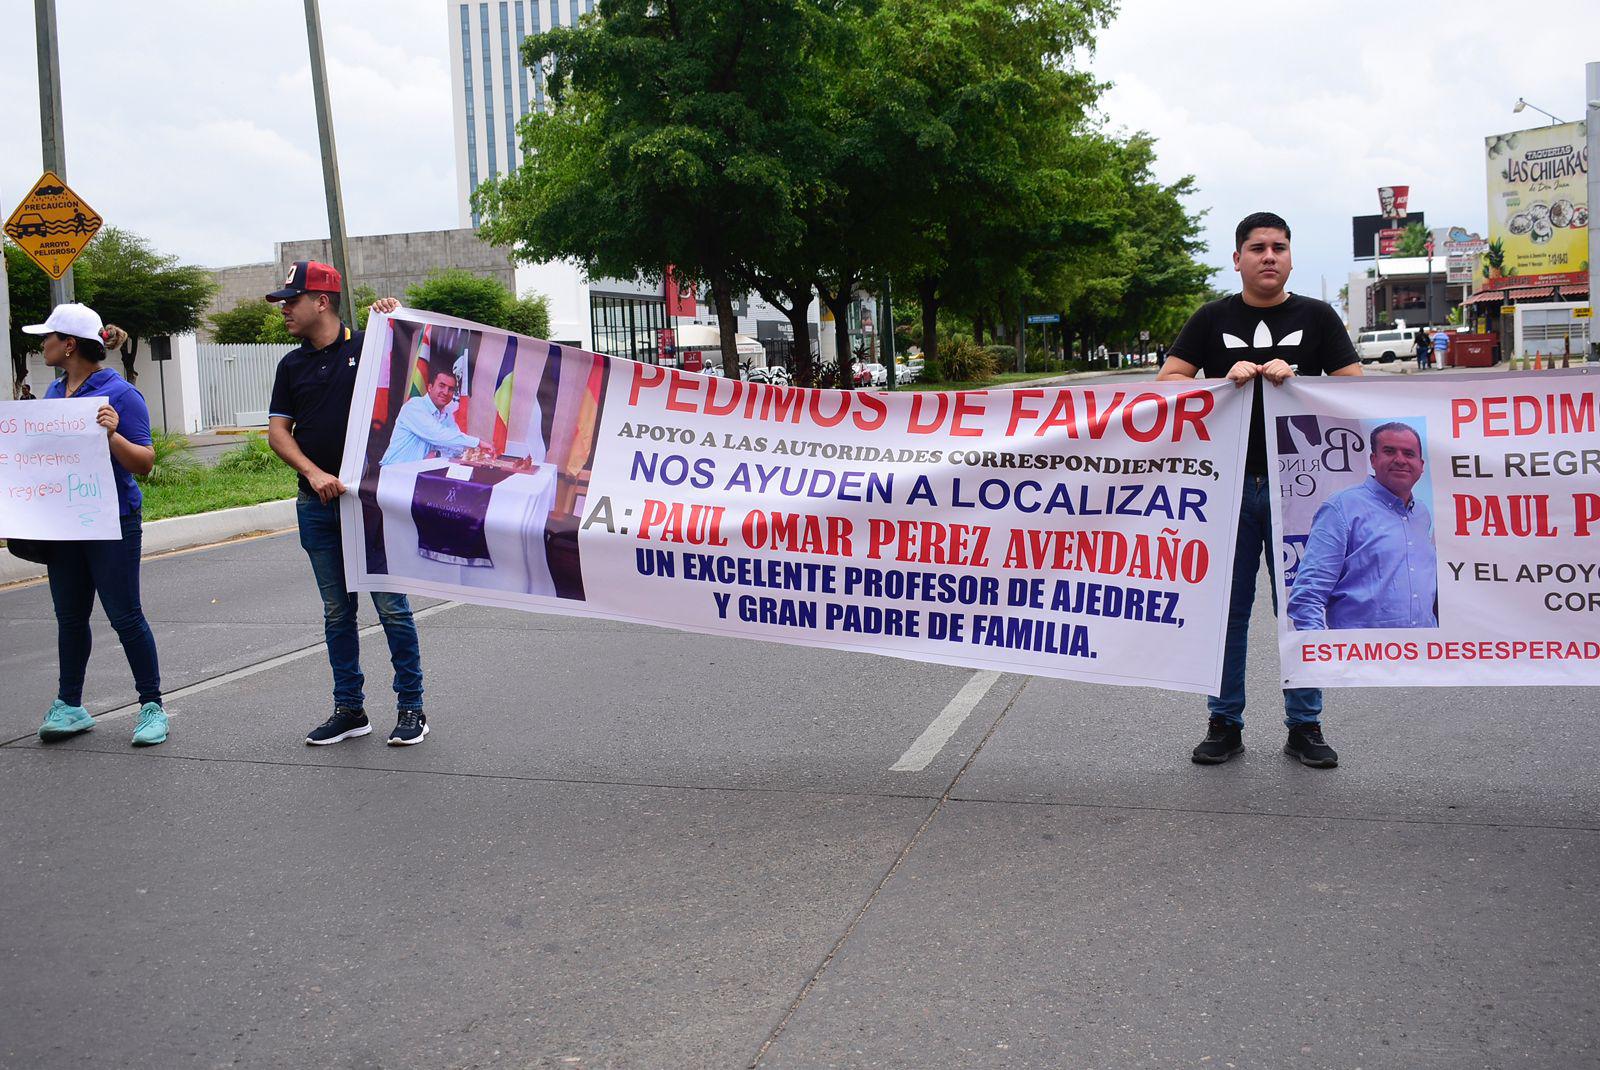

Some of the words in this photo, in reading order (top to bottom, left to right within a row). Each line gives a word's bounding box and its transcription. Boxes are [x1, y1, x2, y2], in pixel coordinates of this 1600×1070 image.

[1508, 158, 1528, 183] LAS
[34, 248, 77, 256] PELIGROSO
[40, 241, 70, 249] ARROYO
[628, 363, 888, 432] PEDIMOS
[906, 390, 988, 437] DE
[1004, 389, 1215, 443] FAVOR
[1451, 392, 1600, 439] PEDIM
[24, 414, 87, 433] maestros
[14, 452, 80, 471] queremos
[617, 422, 696, 445] APOYO
[699, 432, 718, 448] A
[722, 434, 768, 453] LAS
[772, 439, 943, 464] AUTORIDADES
[949, 450, 1220, 482] CORRESPONDIENTES,
[1451, 455, 1493, 478] EL
[1504, 449, 1600, 478] REGR
[9, 482, 63, 501] regreso
[630, 451, 716, 489] NOS
[724, 462, 894, 504] AYUDEN
[906, 475, 938, 506] A
[951, 478, 1208, 522] LOCALIZAR
[1452, 493, 1557, 537] PAUL
[582, 496, 633, 535] A:
[636, 499, 729, 547] PAUL
[741, 509, 853, 557] OMAR
[867, 518, 991, 567] PEREZ
[1002, 527, 1210, 584] AVENDAÑO
[1447, 562, 1465, 581] Y
[1474, 563, 1508, 582] EL
[1515, 563, 1600, 583] APOY
[635, 547, 675, 578] UN
[683, 552, 836, 594] EXCELENTE
[844, 566, 999, 606] PROFESOR
[1007, 578, 1044, 609] DE
[1050, 579, 1185, 629] AJEDREZ,
[713, 592, 731, 619] Y
[738, 595, 817, 628] GRAN
[825, 603, 920, 638] PADRE
[928, 611, 965, 642] DE
[971, 615, 1098, 659] FAMILIA.
[1302, 643, 1418, 662] ESTAMOS
[1427, 641, 1600, 660] DESESPERAD
